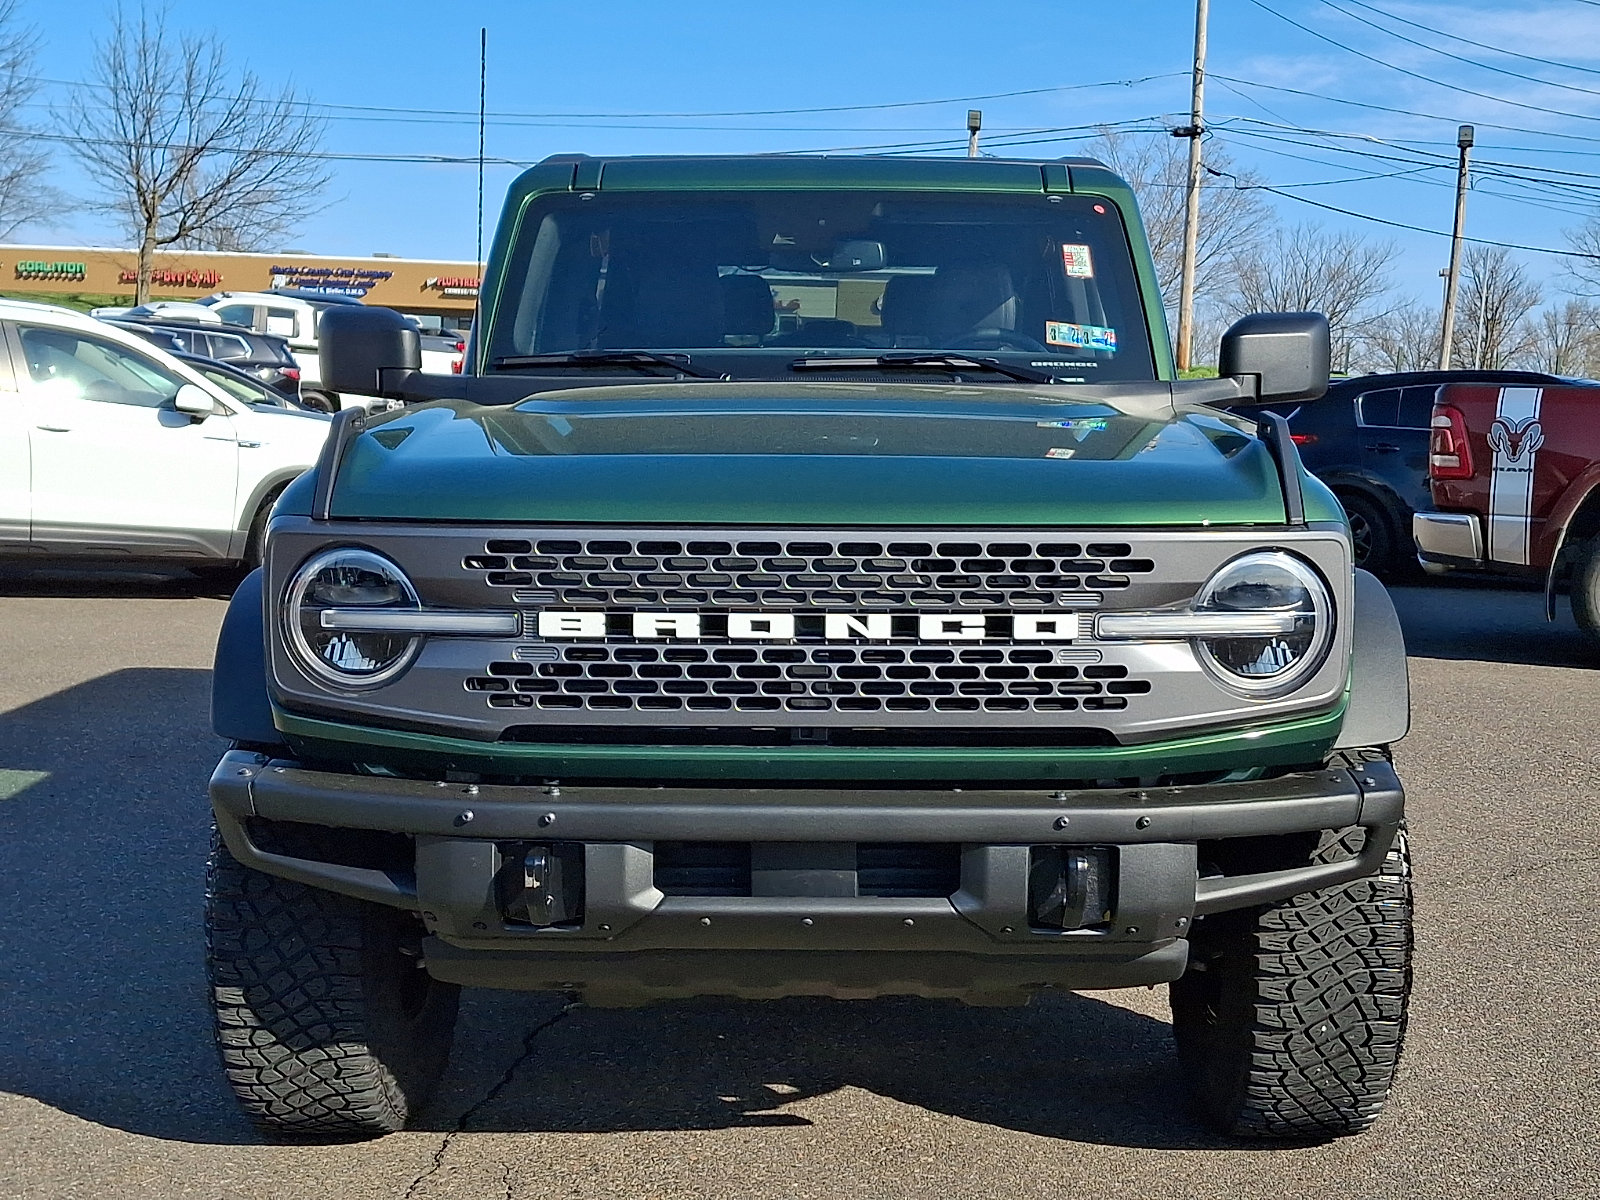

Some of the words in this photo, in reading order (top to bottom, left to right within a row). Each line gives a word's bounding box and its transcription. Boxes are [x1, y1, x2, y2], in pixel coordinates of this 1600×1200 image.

[17, 260, 86, 273] COALITION
[437, 276, 458, 287] PLUM
[459, 278, 478, 288] TREE
[1050, 327, 1056, 341] 3
[1083, 331, 1089, 344] 3
[538, 611, 1078, 640] BRONCO
